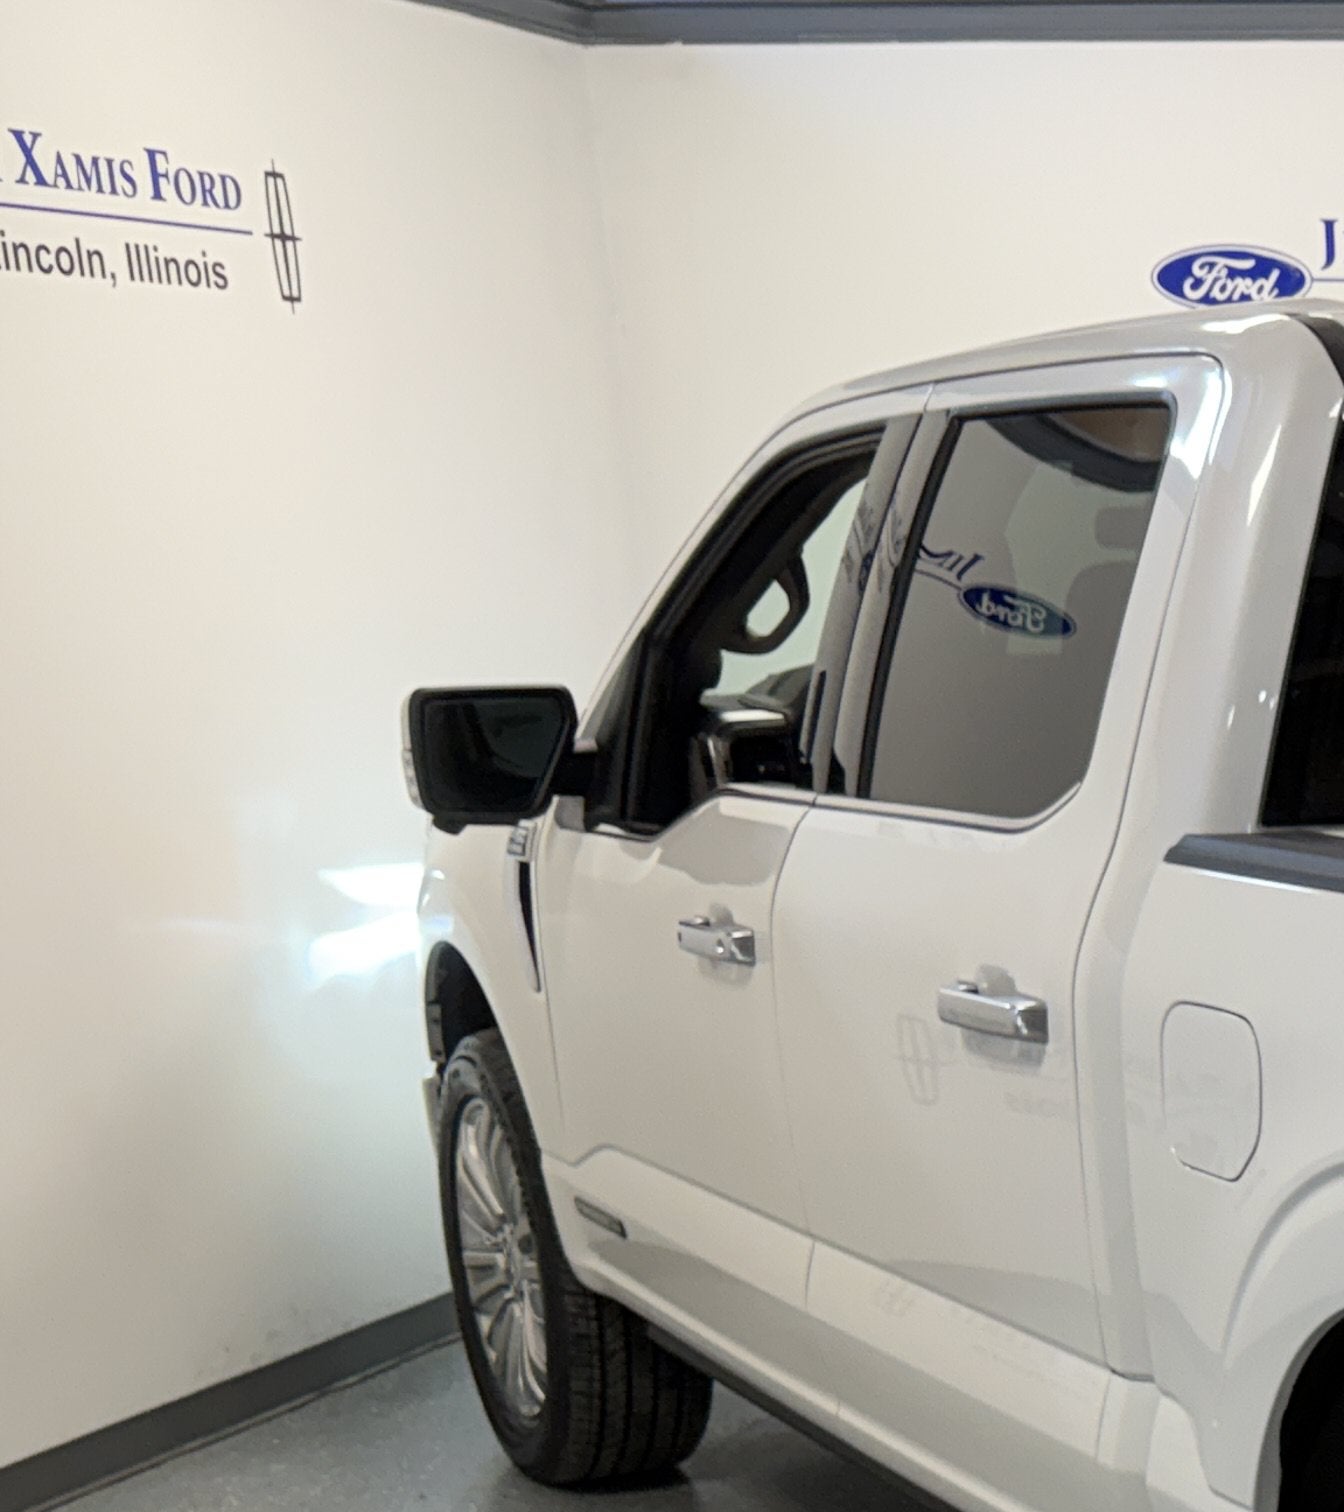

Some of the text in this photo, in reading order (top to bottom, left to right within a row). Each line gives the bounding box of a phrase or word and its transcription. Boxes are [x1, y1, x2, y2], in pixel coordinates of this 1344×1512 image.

[8, 128, 242, 211] XAMIS FORD
[0, 229, 229, 291] incoln, Illinois
[1183, 255, 1280, 302] Ford
